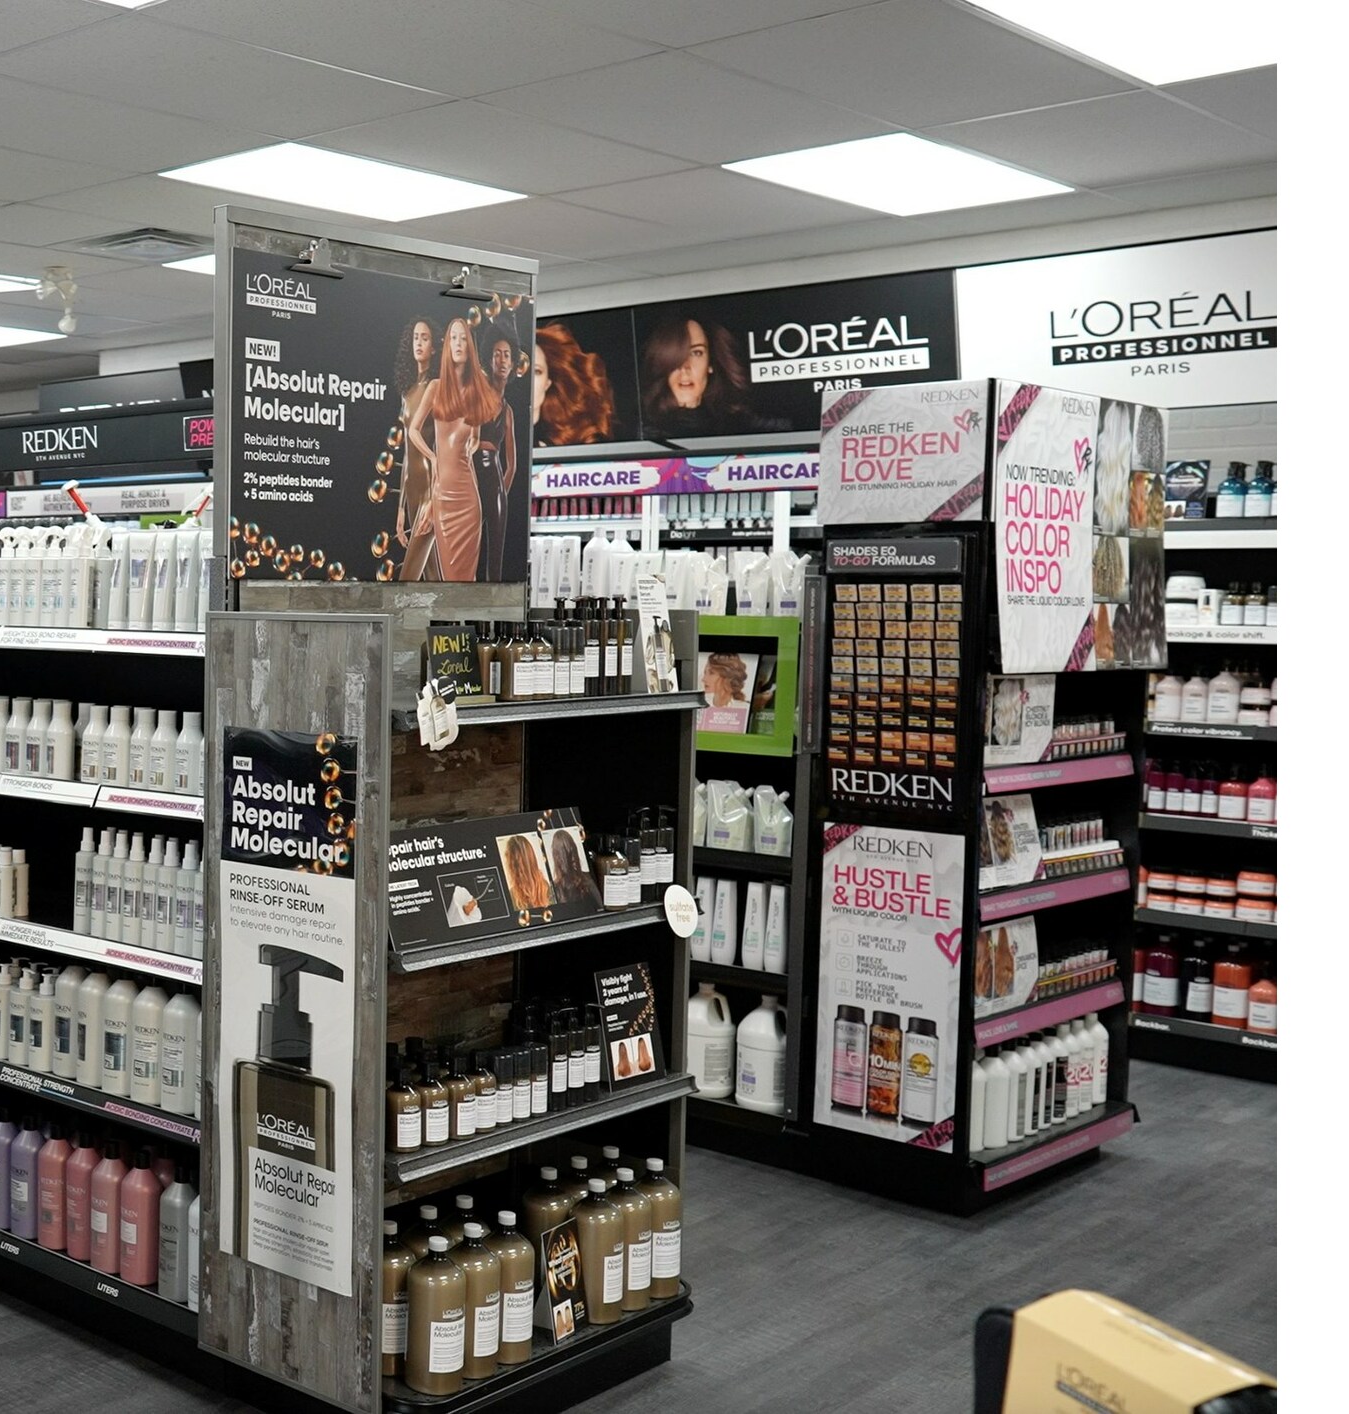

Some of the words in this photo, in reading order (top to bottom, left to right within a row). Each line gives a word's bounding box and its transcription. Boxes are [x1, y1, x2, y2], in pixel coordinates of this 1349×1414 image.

[246, 273, 317, 301] L'ORÉAL
[248, 295, 314, 312] PROFESSIONNEL
[272, 310, 291, 320] PARIS
[1050, 290, 1277, 339] L'ORÉAL
[748, 315, 929, 360] L'ORÉAL
[1060, 331, 1269, 362] PROFESSIONNEL
[249, 342, 277, 358] NEW!
[759, 353, 921, 378] PROFESSIONNEL
[1130, 361, 1191, 377] PARIS
[245, 363, 325, 396] [Absolut
[329, 374, 387, 402] Repair
[813, 378, 862, 393] PARIS
[920, 387, 980, 404] REDKEN
[243, 397, 346, 432] Molecular]
[1061, 395, 1097, 417] REDKEN
[841, 423, 887, 436] SHARE
[889, 422, 914, 434] THE
[22, 425, 98, 454] REDKEN
[243, 433, 279, 448] Rebuild
[280, 435, 295, 448] the
[296, 437, 320, 450] hair's
[841, 431, 961, 459] REDKEN
[243, 450, 290, 464] molecular
[291, 453, 331, 466] structure
[546, 470, 641, 488] HAIRCARE
[840, 458, 912, 483] LOVE
[1005, 464, 1029, 480] NOW
[1030, 466, 1077, 487] TRENDING:
[243, 472, 258, 485] 2%
[259, 474, 300, 488] peptides
[300, 475, 333, 488] bonder
[857, 482, 898, 491] STUNNING
[899, 481, 936, 489] HOLIDAY
[937, 479, 958, 487] HAIR
[251, 489, 258, 500] 5
[258, 490, 288, 501] amino
[288, 490, 314, 502] acids
[1005, 482, 1086, 523] HOLIDAY
[1005, 520, 1071, 558] COLOR
[833, 546, 879, 557] SHADES
[880, 546, 897, 558] EQ
[833, 556, 870, 566] TO-GO
[872, 555, 936, 566] FORMULAS
[1005, 559, 1063, 594] INSPO
[1007, 597, 1025, 606] SHARE
[1025, 597, 1035, 606] THE
[1054, 598, 1071, 607] COLOR
[1071, 598, 1086, 607] LOVE
[152, 639, 197, 649] CONCENTRATE
[433, 632, 465, 655] NEW!
[1152, 725, 1182, 735] Protect
[1183, 727, 1204, 735] color
[235, 759, 250, 768] NEW
[232, 774, 316, 806] Absolut
[831, 767, 952, 802] REDKEN
[832, 793, 855, 802] 5TH
[865, 796, 917, 808] AVENUE
[927, 802, 953, 812] NYC
[232, 801, 303, 831] Repair
[231, 826, 344, 863] Molecular
[413, 836, 445, 853] hair's
[852, 835, 933, 859] REDKEN
[230, 873, 311, 896] PROFESSIONAL
[834, 864, 931, 895] HUSTLE
[230, 889, 283, 908] RINSE-OFF
[286, 898, 325, 915] SERUM
[669, 902, 694, 915] sulfate
[832, 885, 849, 906] &
[855, 888, 951, 920] BUSTLE
[230, 904, 267, 918] Intensive
[269, 910, 308, 926] damage
[309, 917, 336, 931] repair
[676, 911, 691, 924] free
[832, 905, 852, 915] WITH
[853, 908, 879, 919] LIQUID
[880, 911, 908, 923] COLOR
[230, 917, 239, 927] to
[240, 919, 273, 934] elevate
[274, 925, 291, 938] any
[292, 927, 309, 939] hair
[311, 931, 346, 946] routine.
[857, 934, 892, 946] SATURATE
[897, 939, 907, 947] TO
[857, 940, 870, 949] THE
[875, 943, 906, 953] FULLEST
[150, 958, 194, 974] CONCENTRATE
[856, 955, 883, 965] BREEZE
[856, 961, 888, 971] THROUGH
[856, 968, 908, 982] APPLICATIONS
[602, 989, 608, 997] 2
[855, 980, 872, 989] PICK
[877, 984, 895, 992] YOUR
[855, 987, 899, 999] PREFERENCE
[900, 1000, 923, 1010] BRUSH
[0, 1073, 41, 1093] CONCENTRATE
[1, 1066, 42, 1086] PROFESSIONAL
[42, 1079, 74, 1096] STRENGTH
[106, 1102, 125, 1115] ACIDIC
[125, 1107, 150, 1123] BONDING
[150, 1113, 192, 1136] CONCENTRATE
[257, 1113, 315, 1141] L'ORÉAL
[259, 1128, 314, 1148] PROFESSIONNEL
[277, 1141, 295, 1151] PARIS
[255, 1157, 304, 1184] Absolut
[255, 1174, 320, 1208] Molecular
[0, 1240, 20, 1256] LITERS
[97, 1282, 120, 1299] LITERS
